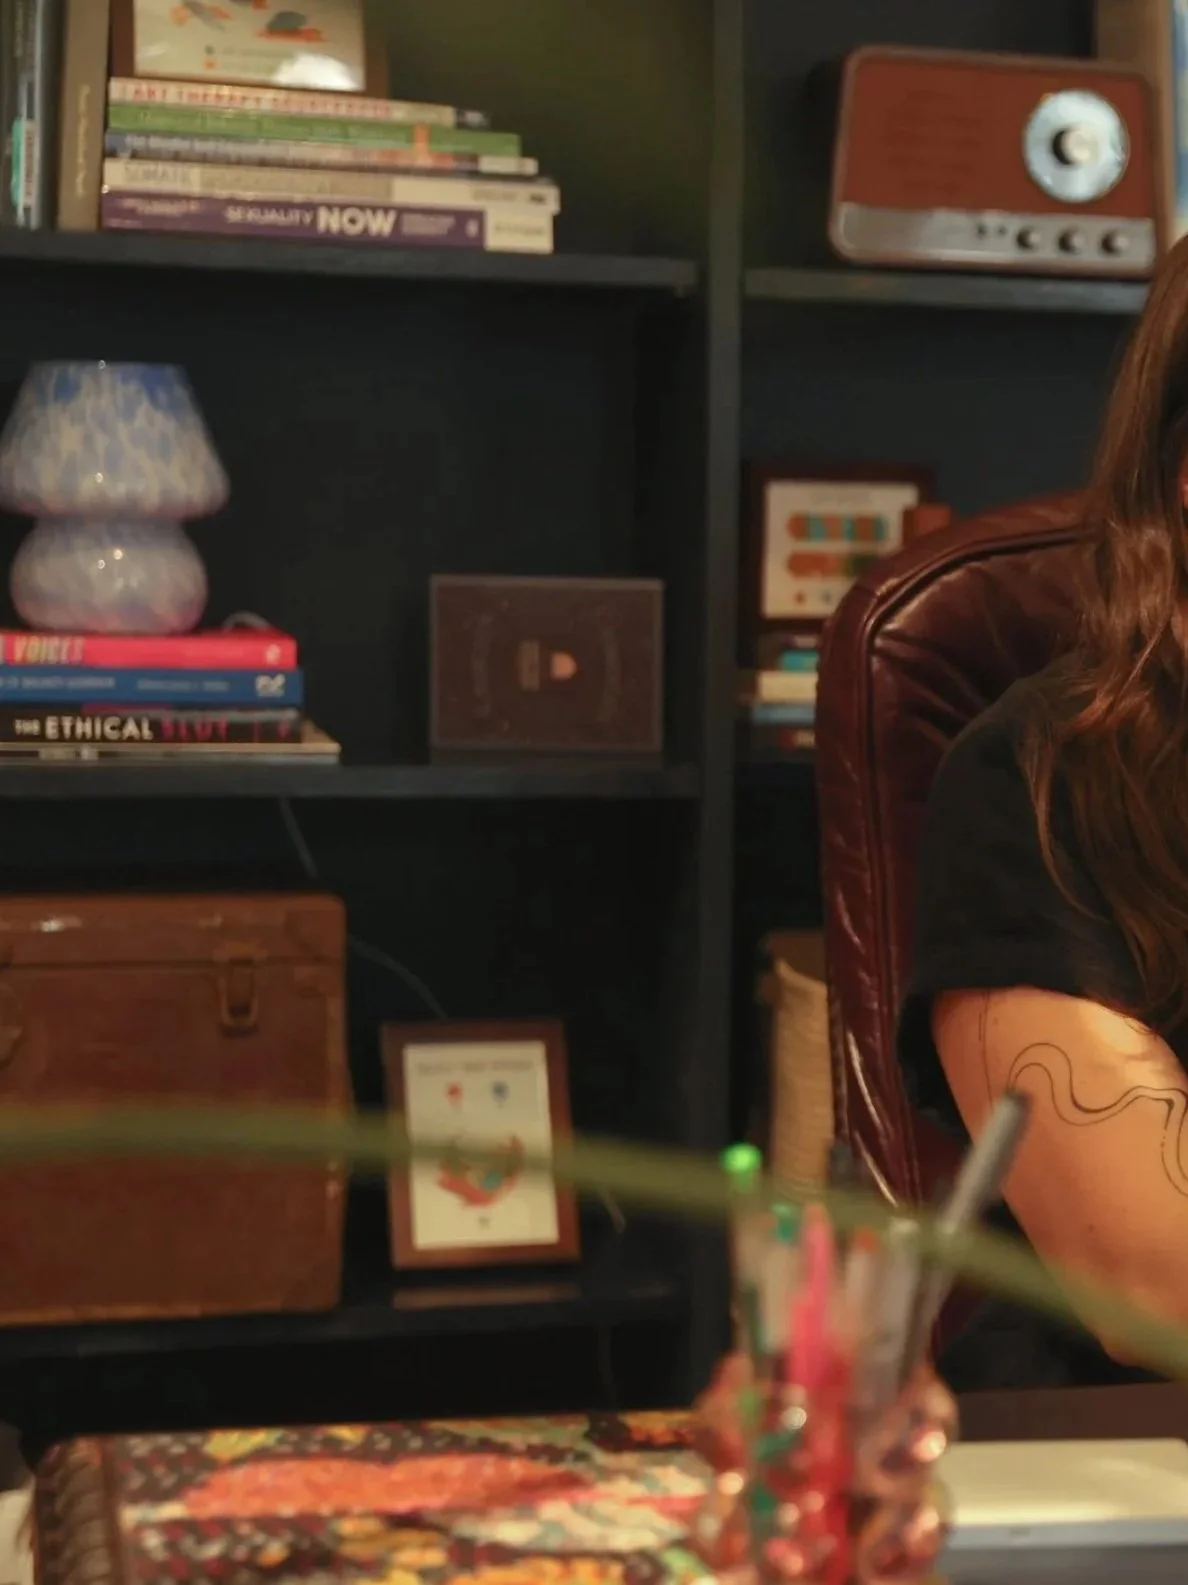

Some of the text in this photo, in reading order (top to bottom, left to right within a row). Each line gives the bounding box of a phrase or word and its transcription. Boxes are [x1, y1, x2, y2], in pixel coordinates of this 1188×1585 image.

[226, 205, 314, 227] SEXUALITY
[316, 205, 397, 238] NOW
[13, 718, 41, 736] THE
[45, 715, 153, 741] ETHICAL
